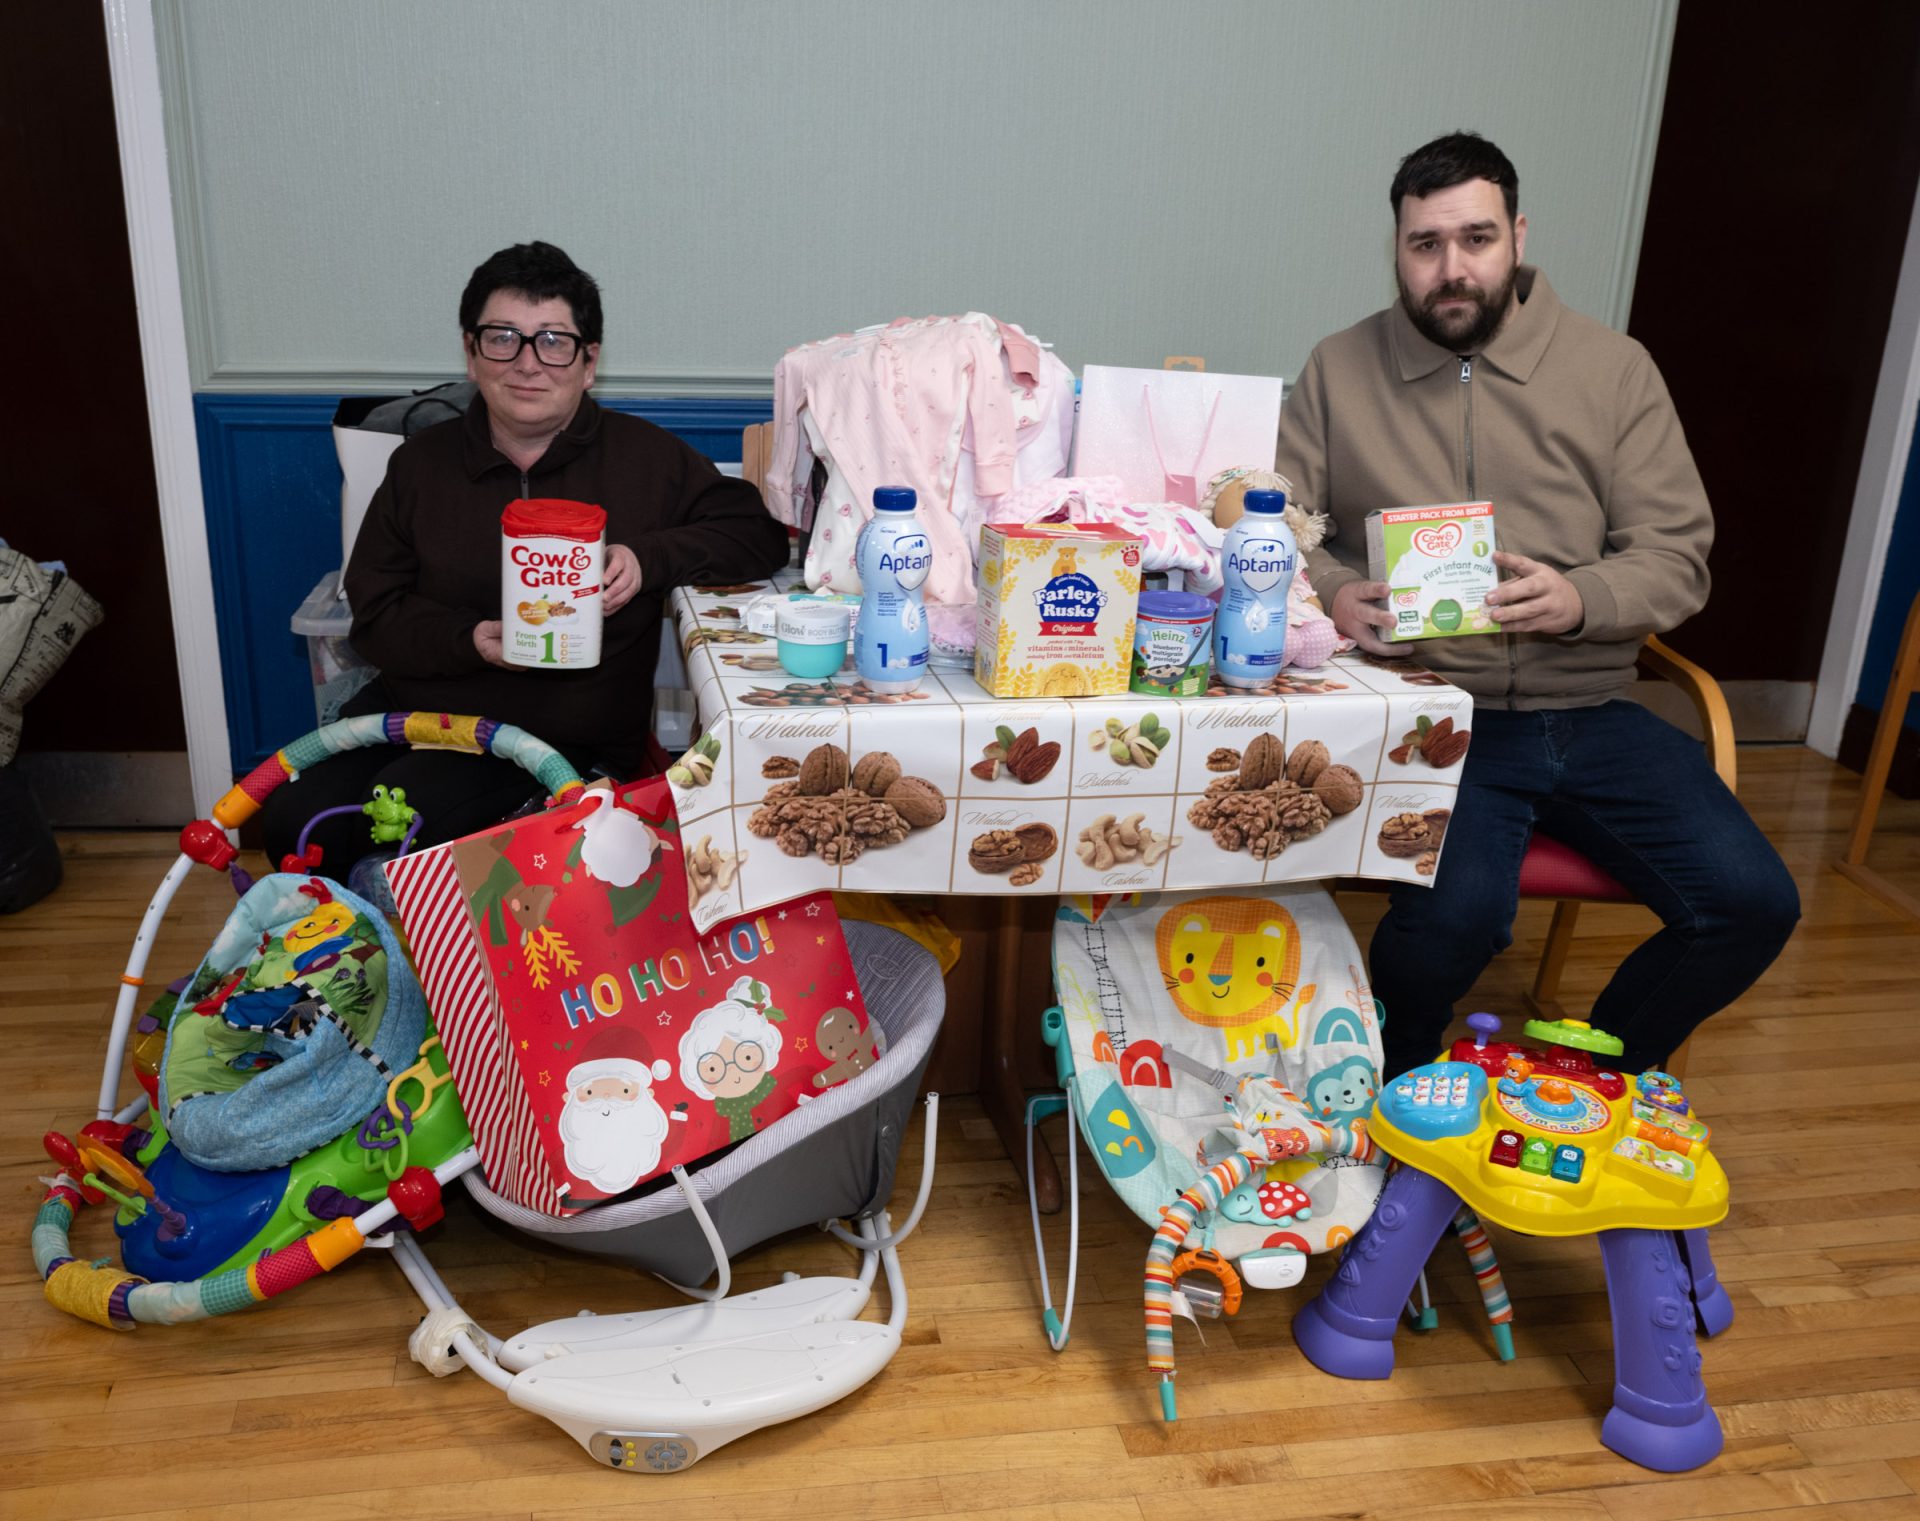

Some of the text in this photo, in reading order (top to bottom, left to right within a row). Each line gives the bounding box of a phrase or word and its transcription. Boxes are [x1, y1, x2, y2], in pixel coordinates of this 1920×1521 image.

[1387, 507, 1488, 523] STARTER PACK FROM BIRTH
[1427, 540, 1451, 551] Gate
[1477, 543, 1484, 556] 1
[879, 553, 932, 574] Aptam
[1228, 553, 1293, 573] Aptamil
[1423, 566, 1442, 582] First
[1443, 561, 1471, 571] infant
[1473, 563, 1493, 576] milk
[520, 567, 581, 588] Gate
[1033, 585, 1108, 607] Farley's
[1043, 603, 1095, 618] Rusks
[1052, 624, 1086, 635] Original
[1152, 630, 1186, 643] Heinz
[515, 631, 537, 640] From
[540, 631, 558, 663] 1
[877, 643, 888, 668] 1
[1152, 643, 1183, 651] blueberry
[1220, 635, 1229, 660] 1
[738, 710, 850, 739] Walnut
[1188, 702, 1283, 730] Walnut
[560, 916, 776, 1029] HO HO HO!
